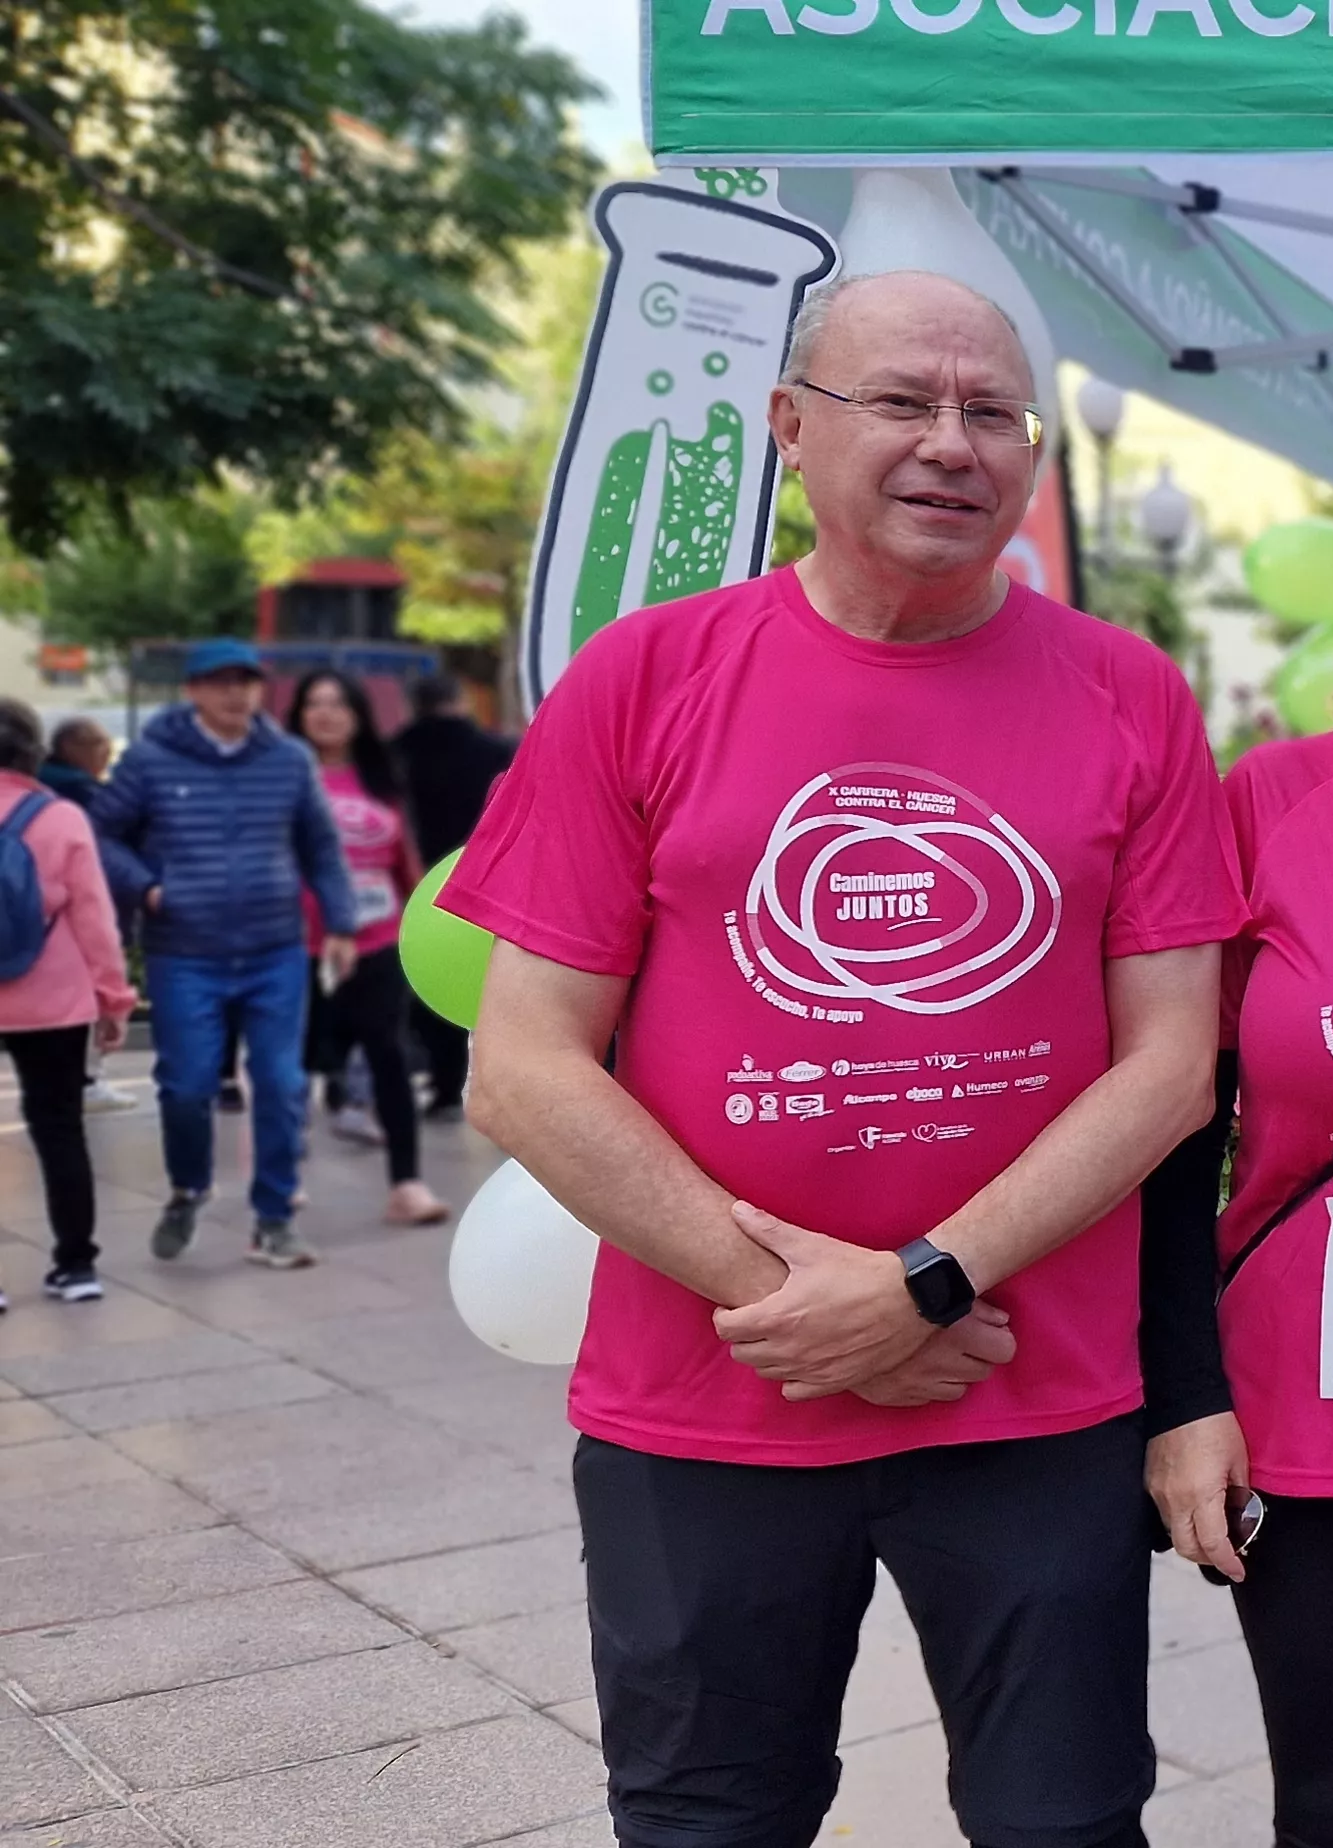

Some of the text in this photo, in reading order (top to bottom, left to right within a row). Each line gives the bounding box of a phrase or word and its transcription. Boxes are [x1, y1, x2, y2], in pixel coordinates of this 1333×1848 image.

[828, 786, 956, 806] X CARRERA HUESCA
[836, 797, 886, 809] CONTRA
[888, 800, 904, 810] EL
[829, 871, 935, 893] Caminemos
[836, 892, 929, 921] JUNTOS
[826, 1010, 864, 1024] apoyo
[785, 1067, 820, 1079] Ferrer
[924, 1051, 969, 1071] vive
[984, 1049, 1026, 1061] URBAN
[966, 1080, 1009, 1093] Humeco
